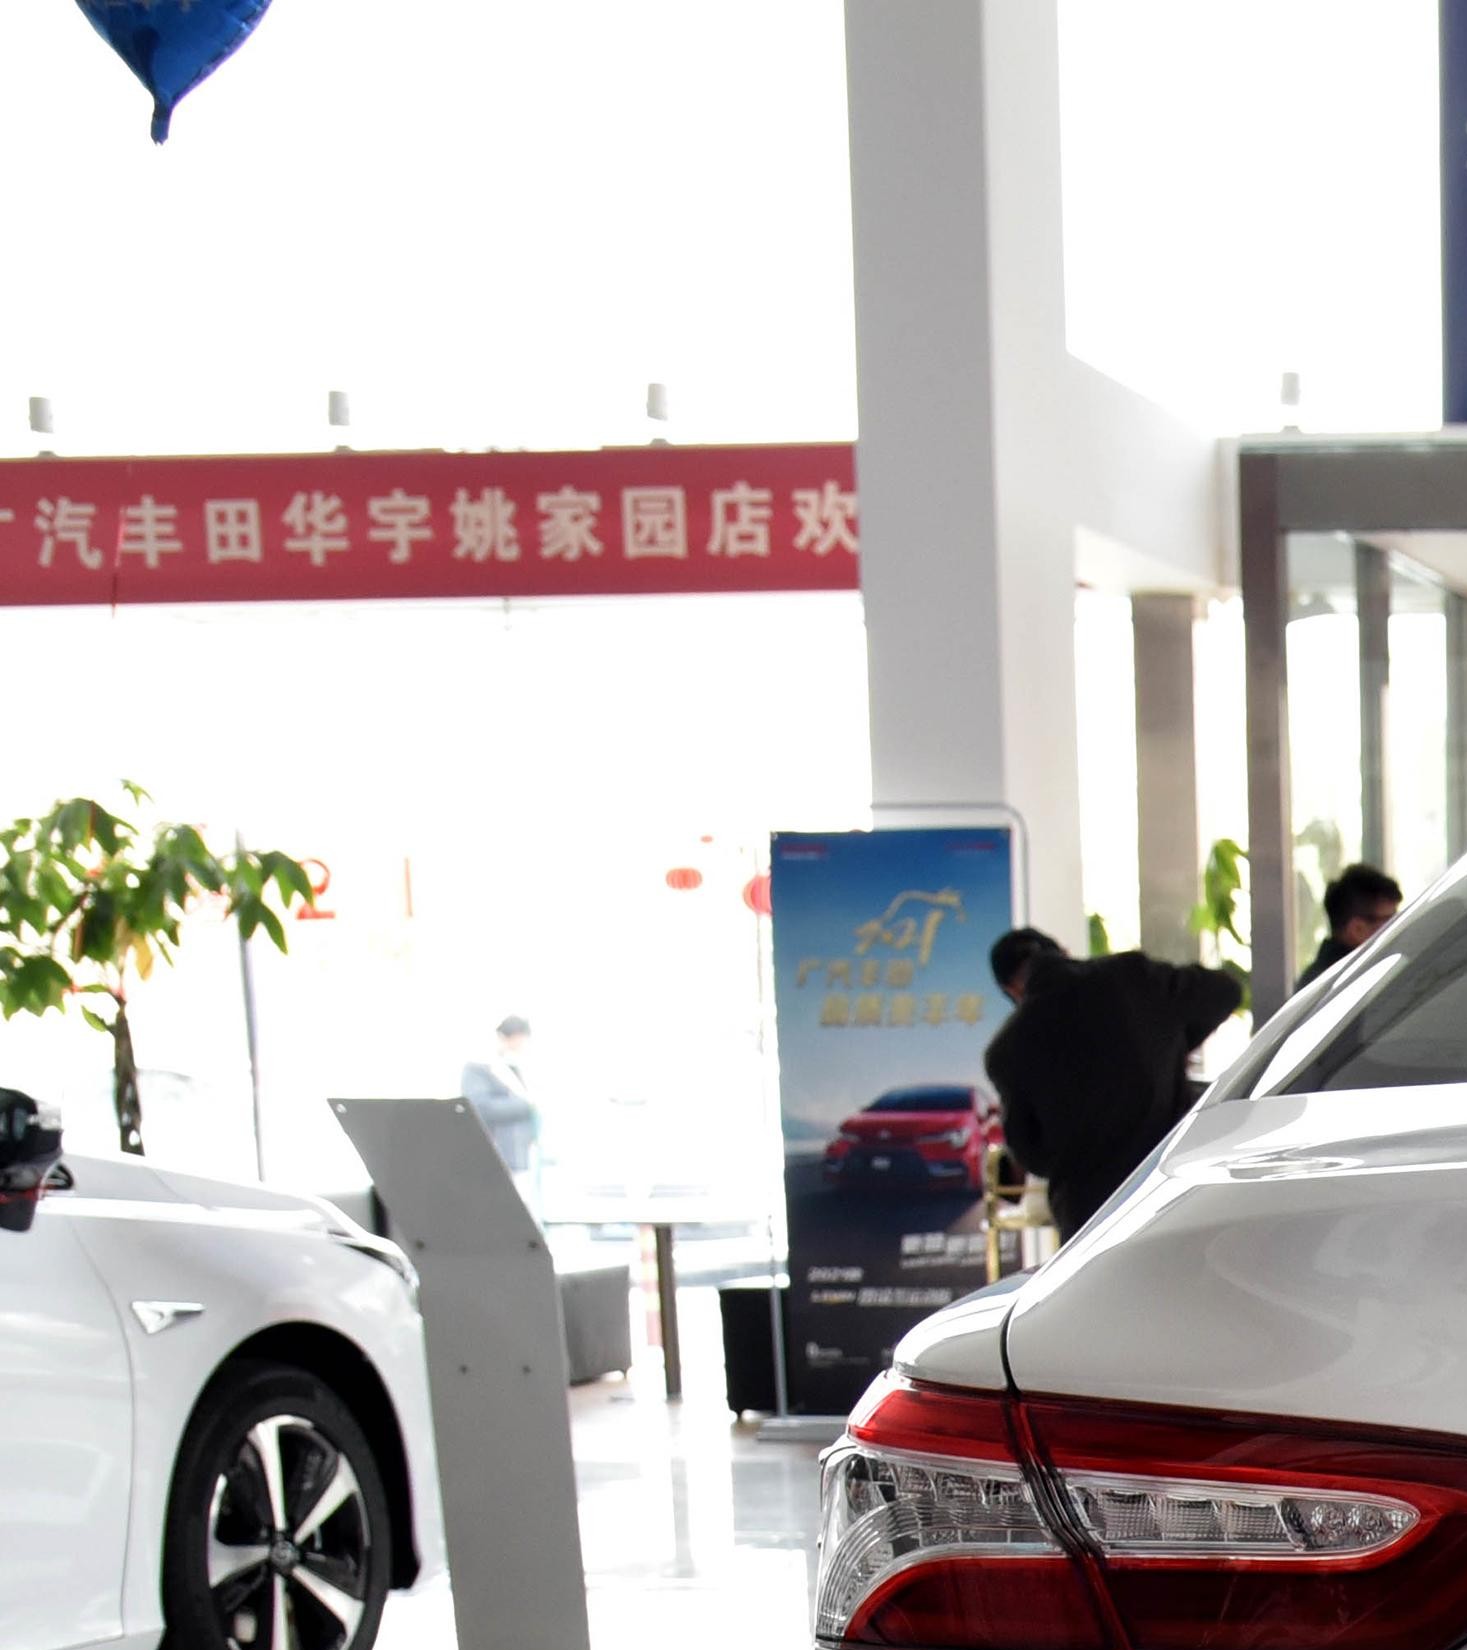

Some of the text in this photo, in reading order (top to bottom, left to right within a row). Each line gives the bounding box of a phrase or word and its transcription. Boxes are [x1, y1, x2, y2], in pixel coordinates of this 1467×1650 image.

[0, 481, 857, 569] 汽丰田华宇姚家园店欢
